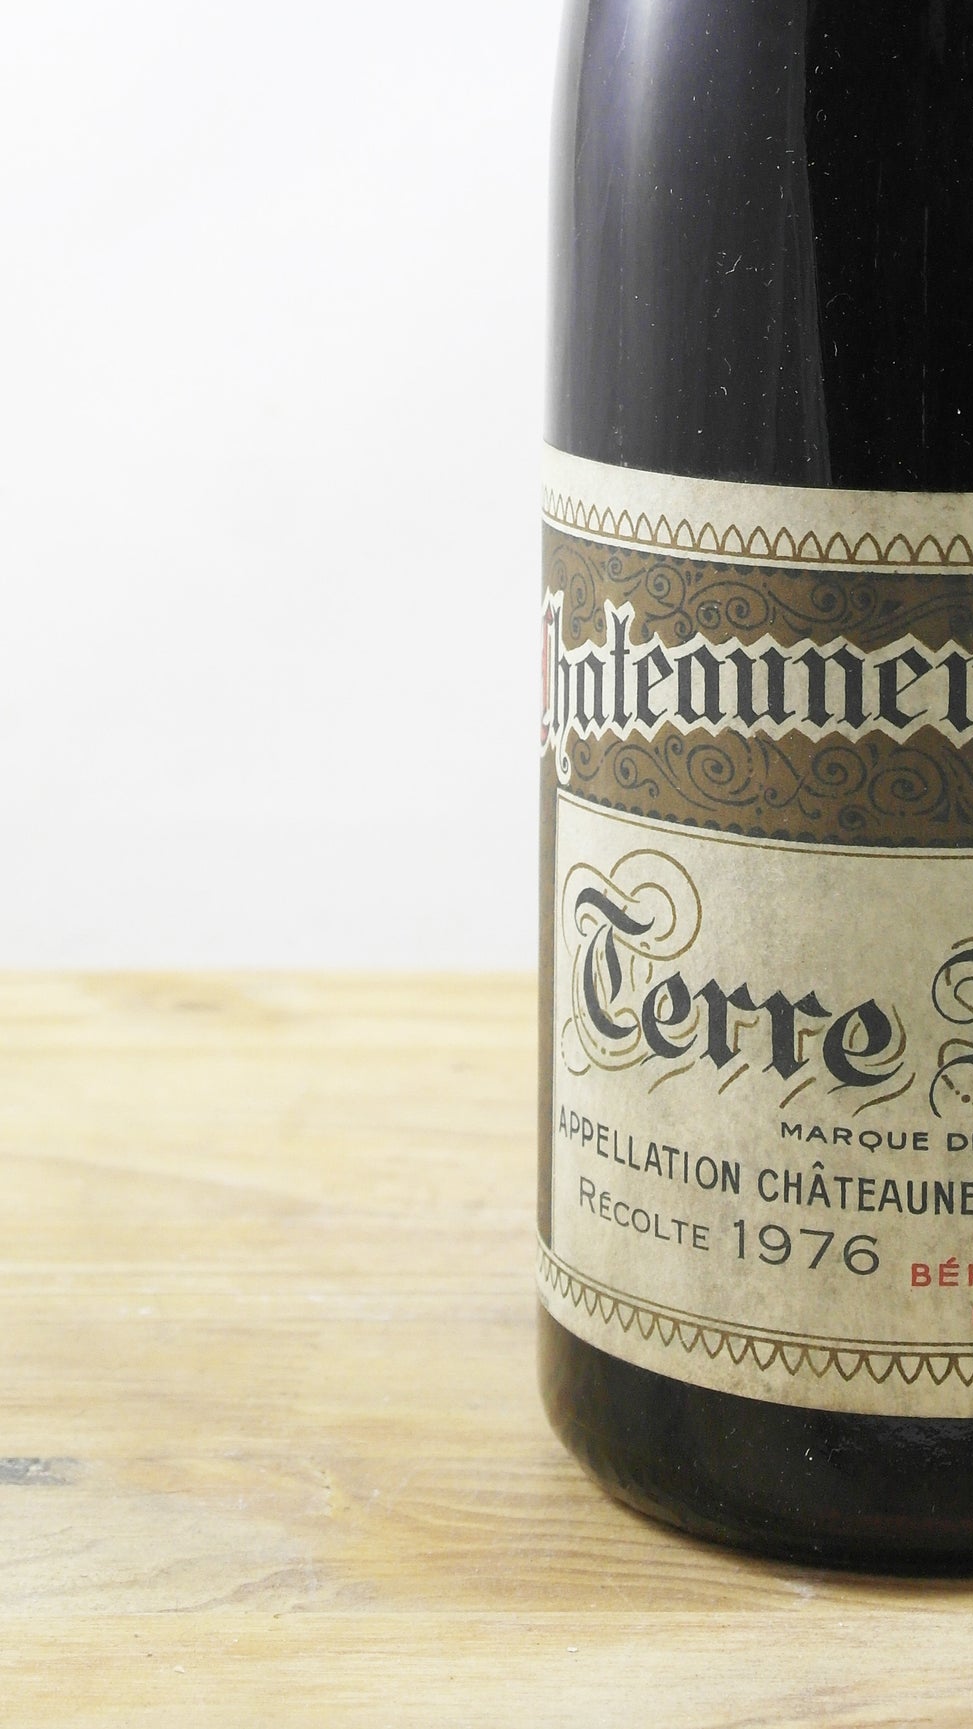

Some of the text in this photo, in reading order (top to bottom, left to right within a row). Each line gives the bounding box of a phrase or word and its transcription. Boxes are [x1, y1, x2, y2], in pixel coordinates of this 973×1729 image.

[573, 886, 905, 1095] Terre
[558, 1104, 741, 1196] APPELLATION
[780, 1121, 930, 1152] MARQUE
[579, 1176, 881, 1276] RÉCOLTE 1976
